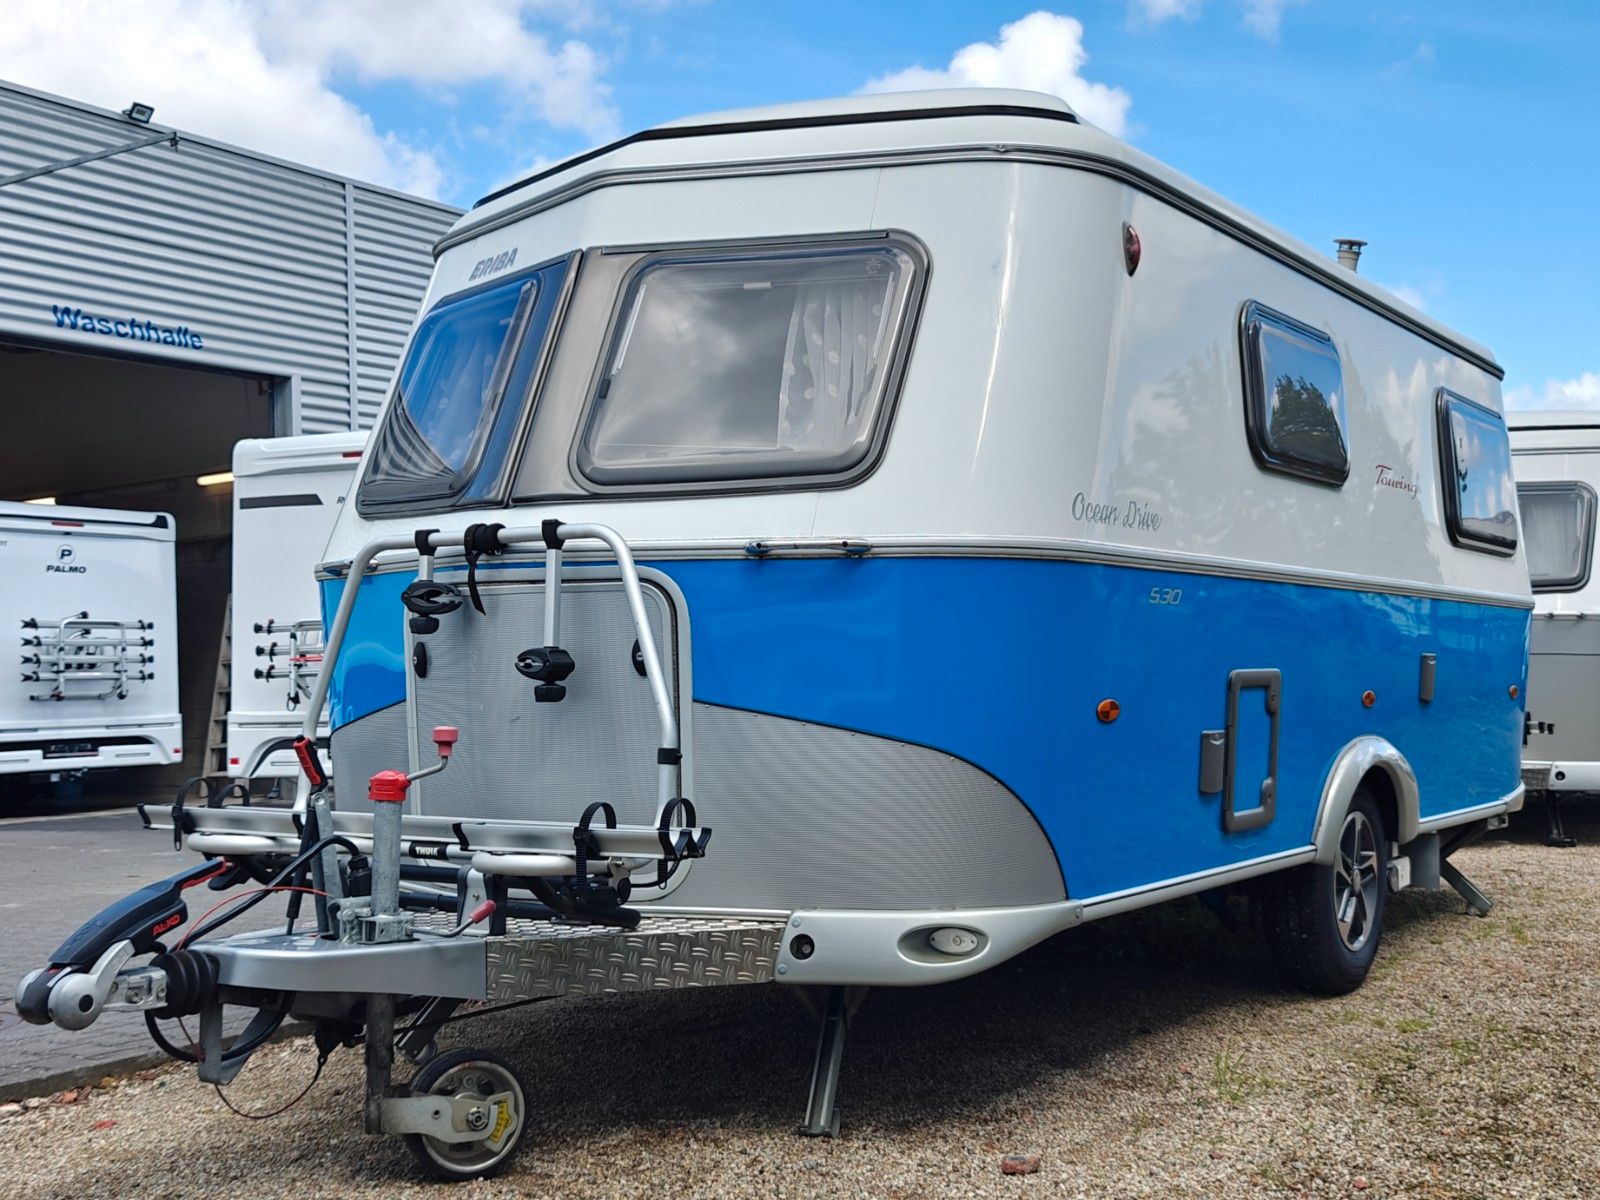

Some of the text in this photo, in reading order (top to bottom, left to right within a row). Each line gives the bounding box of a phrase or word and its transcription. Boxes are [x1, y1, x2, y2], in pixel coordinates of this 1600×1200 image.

[468, 247, 518, 282] ERIBA
[52, 304, 204, 350] Waschhalle
[1375, 464, 1418, 500] Touring
[1071, 491, 1163, 531] Ocean Drive
[46, 564, 87, 574] PALMO
[1149, 587, 1182, 605] 530
